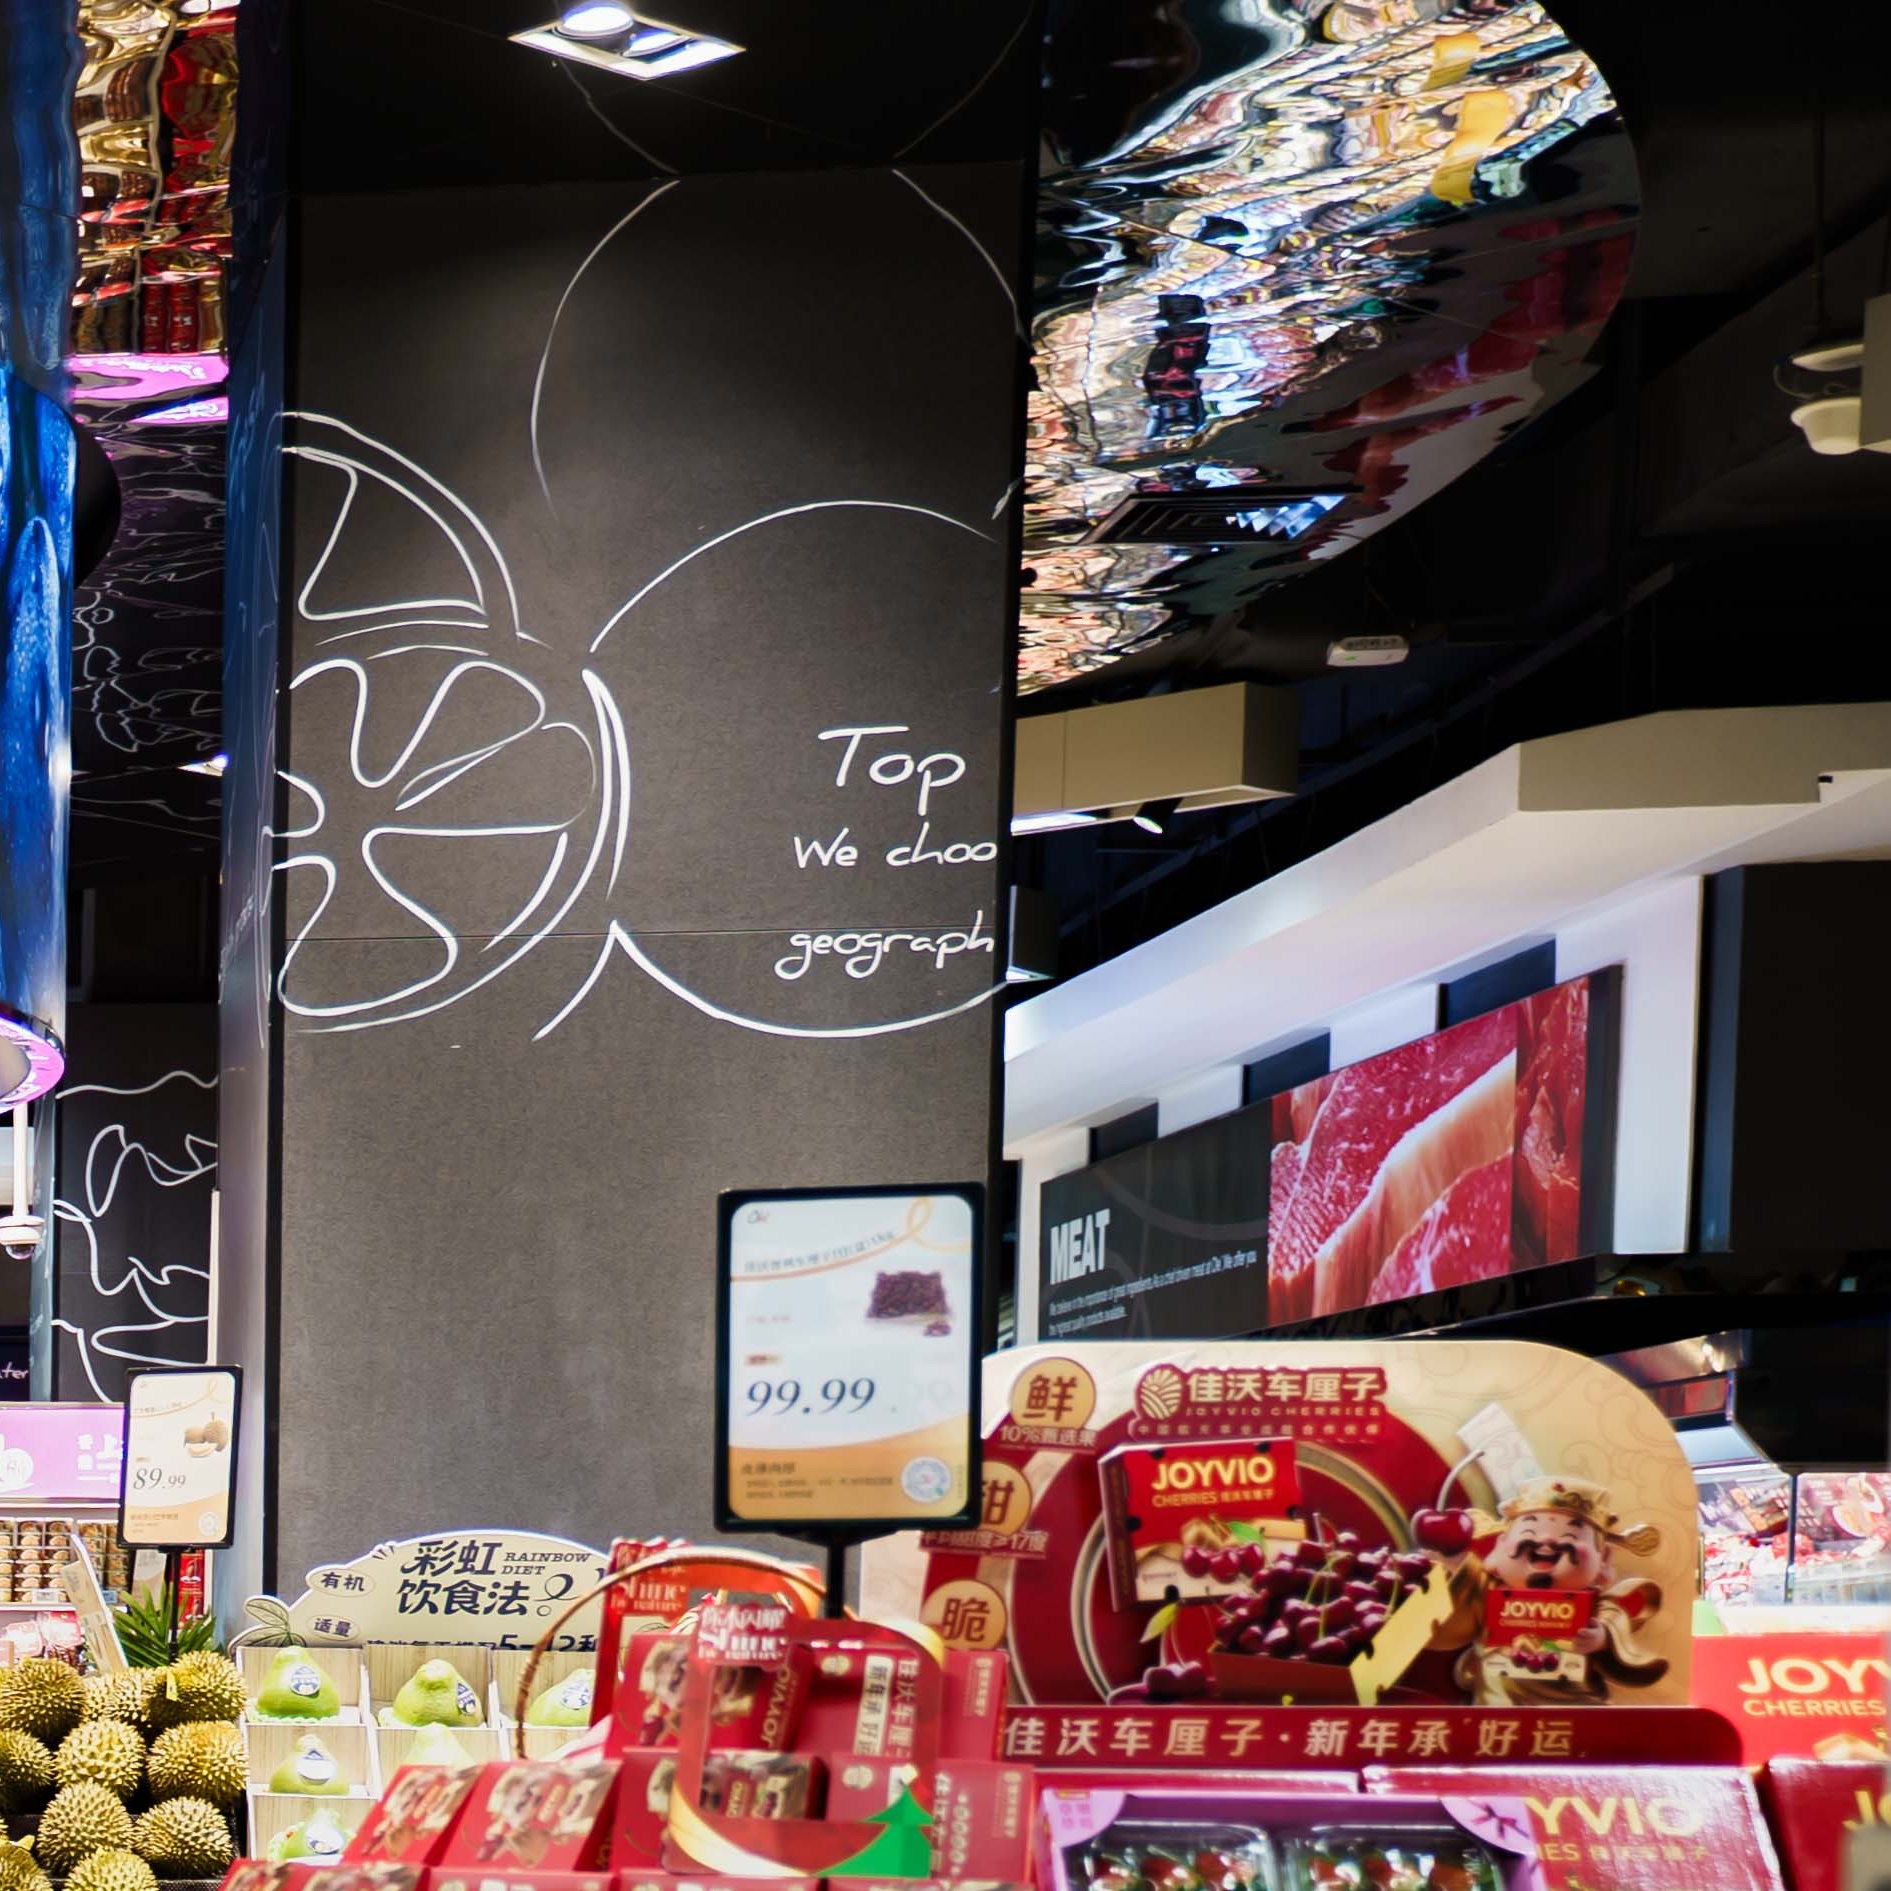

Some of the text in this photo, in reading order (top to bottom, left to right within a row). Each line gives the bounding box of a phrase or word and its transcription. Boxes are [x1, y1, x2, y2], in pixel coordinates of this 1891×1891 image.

[818, 725, 965, 816] Top
[793, 827, 859, 869] We
[1050, 1208, 1111, 1285] MEAT
[746, 1377, 875, 1417] 99.99
[1023, 1374, 1078, 1423] 鲜
[1187, 1372, 1381, 1403] 佳沃车厘子
[1185, 1405, 1381, 1417] JOYVIO CHERRIES
[132, 1466, 187, 1491] 89.99
[1152, 1456, 1275, 1492] JOYVIO
[1152, 1492, 1217, 1509] CHERRIES
[400, 1539, 503, 1577] 彩虹
[502, 1565, 546, 1575] DIET
[503, 1552, 591, 1563] RAINBOW
[321, 1571, 366, 1592] 有机
[397, 1578, 530, 1616] 饮食法
[314, 1617, 353, 1638] 适量
[940, 1597, 986, 1644] 脆
